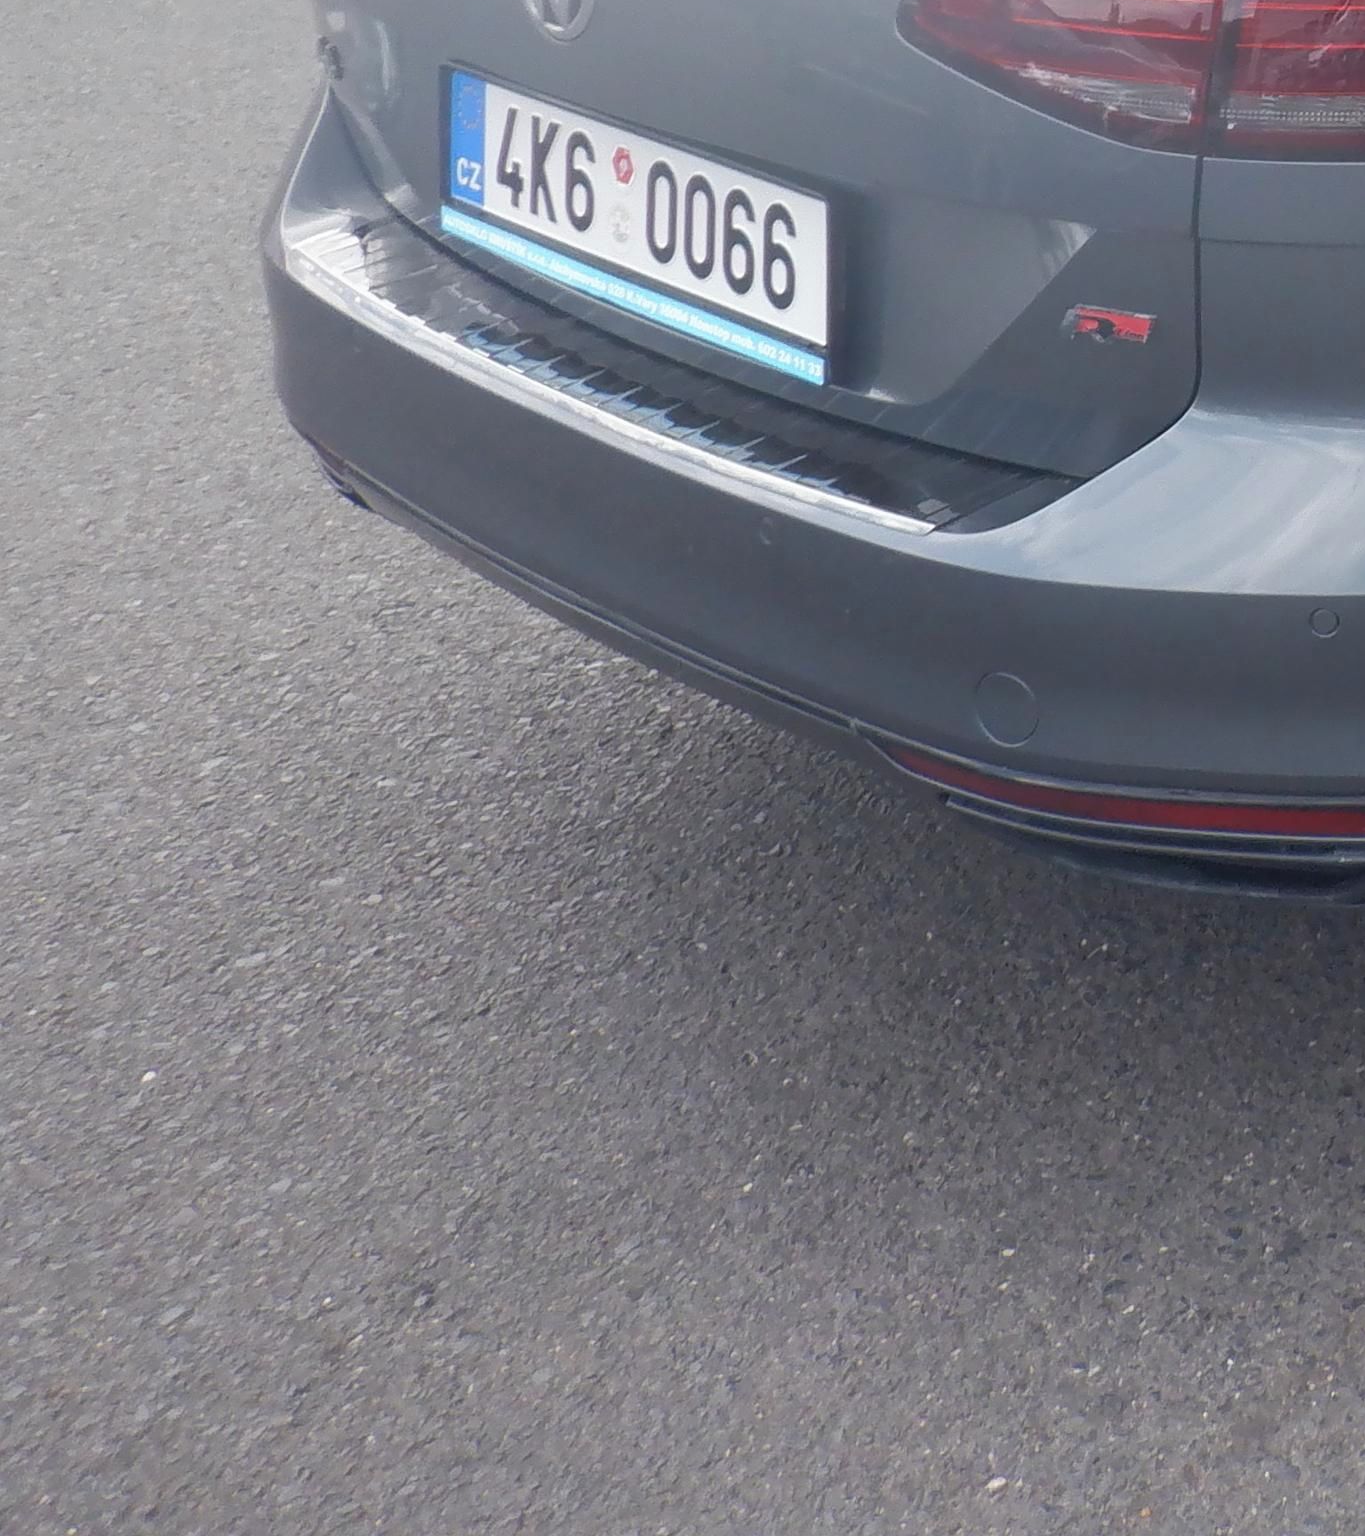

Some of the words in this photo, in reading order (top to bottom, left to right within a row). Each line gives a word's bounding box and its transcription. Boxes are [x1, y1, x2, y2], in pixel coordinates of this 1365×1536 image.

[457, 157, 481, 191] CZ
[497, 107, 595, 232] 4K6
[645, 160, 796, 310] 0066
